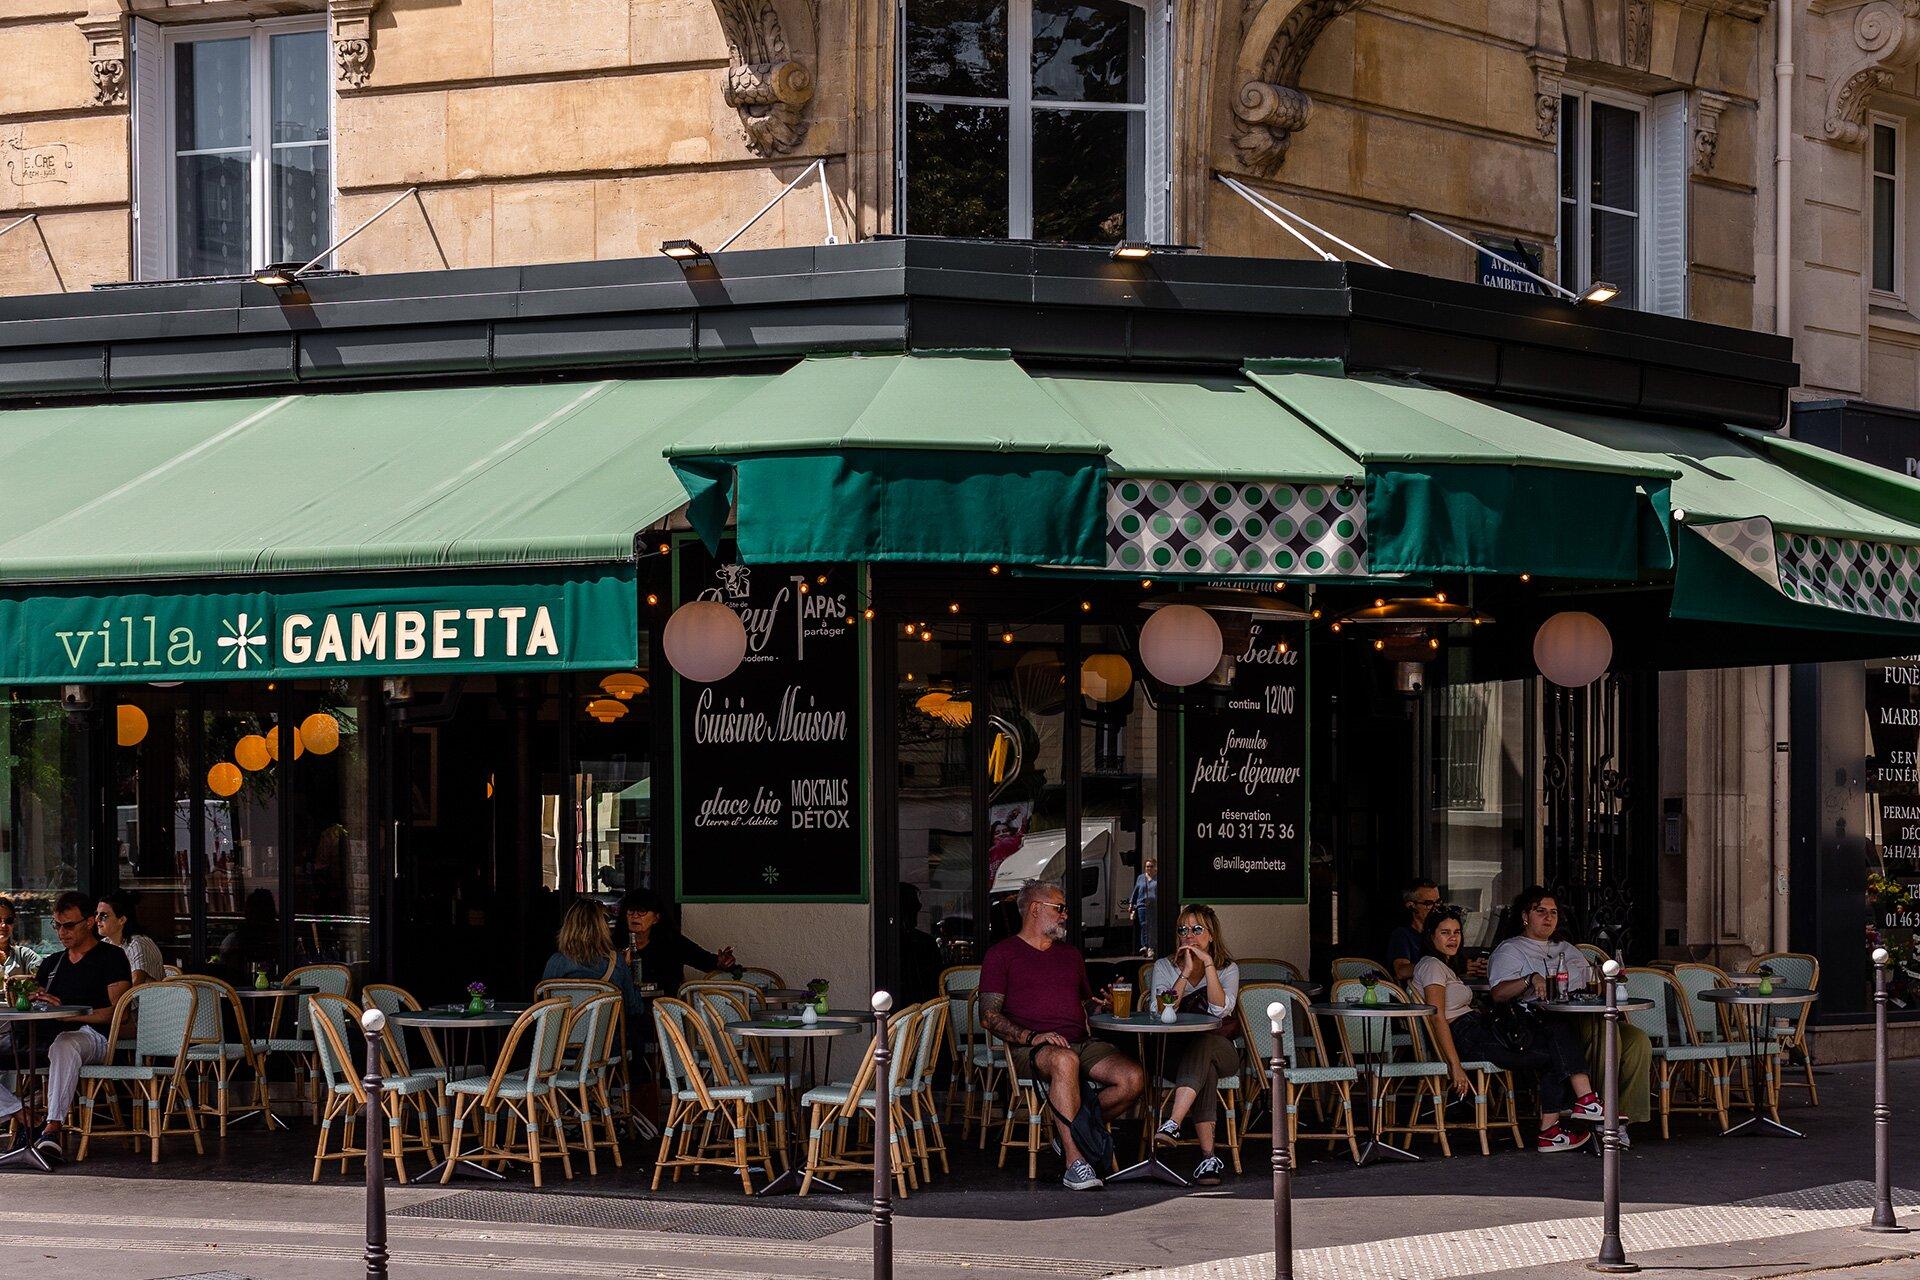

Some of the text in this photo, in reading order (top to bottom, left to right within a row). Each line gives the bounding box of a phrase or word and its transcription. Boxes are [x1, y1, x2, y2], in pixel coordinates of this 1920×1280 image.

[1483, 274, 1535, 293] GAMBETTA
[55, 606, 559, 669] villa GAMBETTA
[804, 627, 845, 638] partager
[695, 684, 848, 744] Cuisine Maison
[1228, 699, 1260, 710] continu
[1881, 707, 1920, 726] MARB
[1220, 728, 1268, 756] formules
[791, 778, 849, 806] MOKTAILS
[695, 786, 782, 827] glace bio
[1221, 808, 1271, 821] réservation
[791, 807, 850, 829] DÉTOX
[1197, 823, 1296, 840] 01 40 31 75 36
[1213, 856, 1287, 873] @lavillagambetta
[1885, 912, 1898, 928] 01
[1900, 911, 1912, 928] 46
